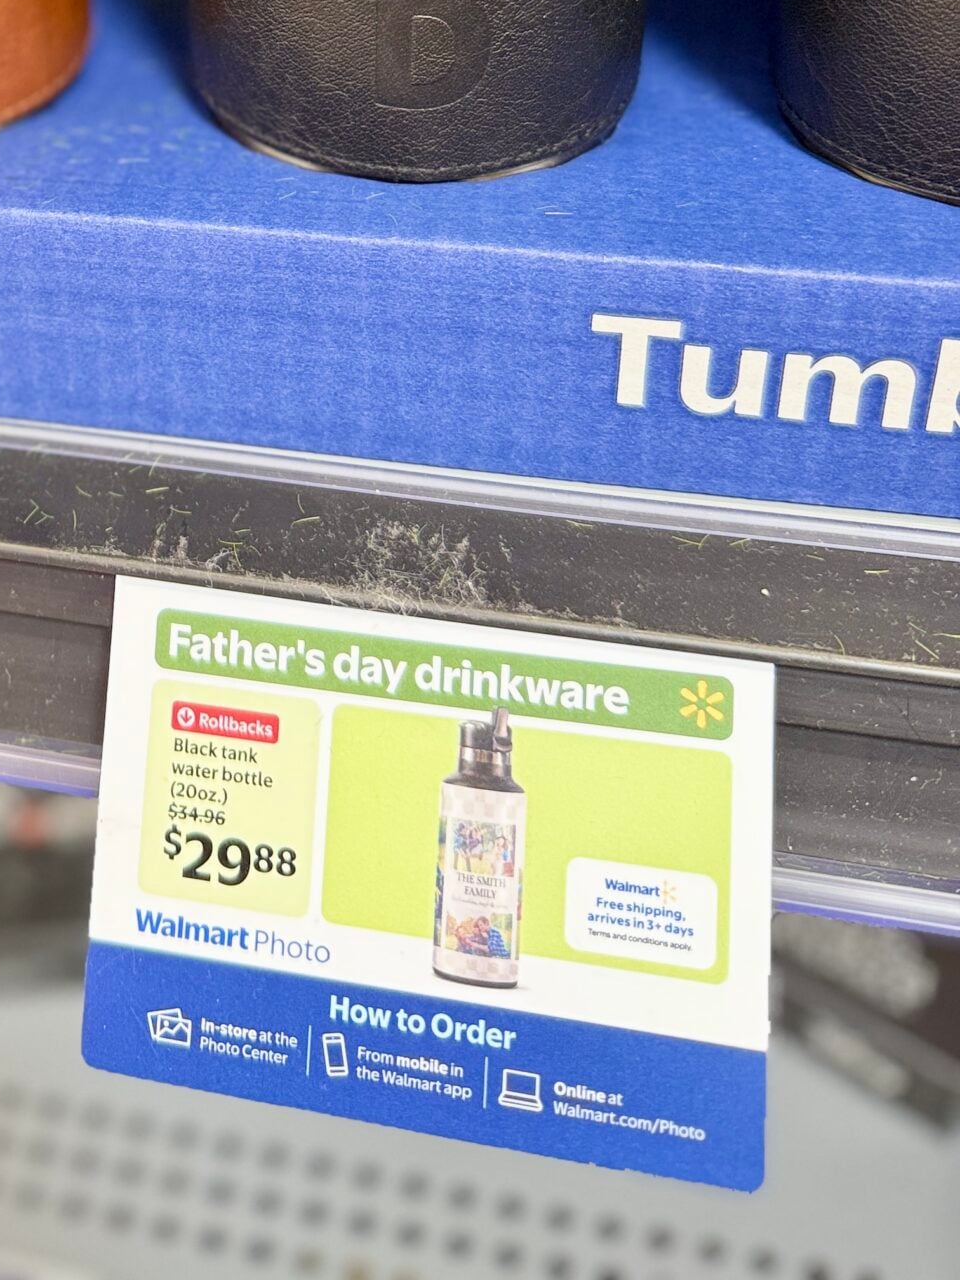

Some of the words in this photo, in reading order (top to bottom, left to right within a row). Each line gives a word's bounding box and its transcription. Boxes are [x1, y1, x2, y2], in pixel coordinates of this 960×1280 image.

[168, 622, 327, 677] Father's
[332, 645, 408, 695] day
[414, 655, 630, 715] drinkware
[199, 712, 273, 737] Rollbacks
[173, 737, 217, 758] Black
[221, 745, 258, 764] tank
[171, 762, 218, 780] water
[221, 766, 273, 788] bottle
[170, 781, 228, 805] (20oz.)
[168, 802, 226, 826] $34.96
[456, 871, 475, 884] THE
[476, 875, 506, 889] SMITH
[464, 885, 497, 899] FAMILY
[604, 878, 661, 897] Walmart
[596, 897, 624, 910] Free
[626, 901, 686, 922] shipping,
[136, 907, 249, 950] Walmart
[254, 929, 331, 964] Photo
[587, 912, 631, 927] arrives
[633, 916, 645, 929] in
[647, 919, 662, 931] 3+
[664, 923, 694, 938] days
[587, 928, 611, 939] Terms
[612, 933, 627, 941] and
[628, 935, 669, 948] conditions
[200, 1017, 258, 1041] In-store
[259, 1029, 273, 1043] at
[275, 1031, 298, 1048] the
[329, 994, 392, 1028] How
[395, 1008, 426, 1034] to
[431, 1012, 517, 1050] Order
[199, 1036, 240, 1056] Photo
[241, 1045, 288, 1065] Center
[357, 1045, 394, 1065] From
[396, 1055, 449, 1075] mobile
[450, 1062, 464, 1078] in
[356, 1065, 380, 1082] the
[382, 1069, 442, 1094] Walmart
[443, 1083, 473, 1101] app
[553, 1081, 607, 1103] Online
[607, 1092, 624, 1107] at
[553, 1100, 707, 1141] Walmart.com/Photo
